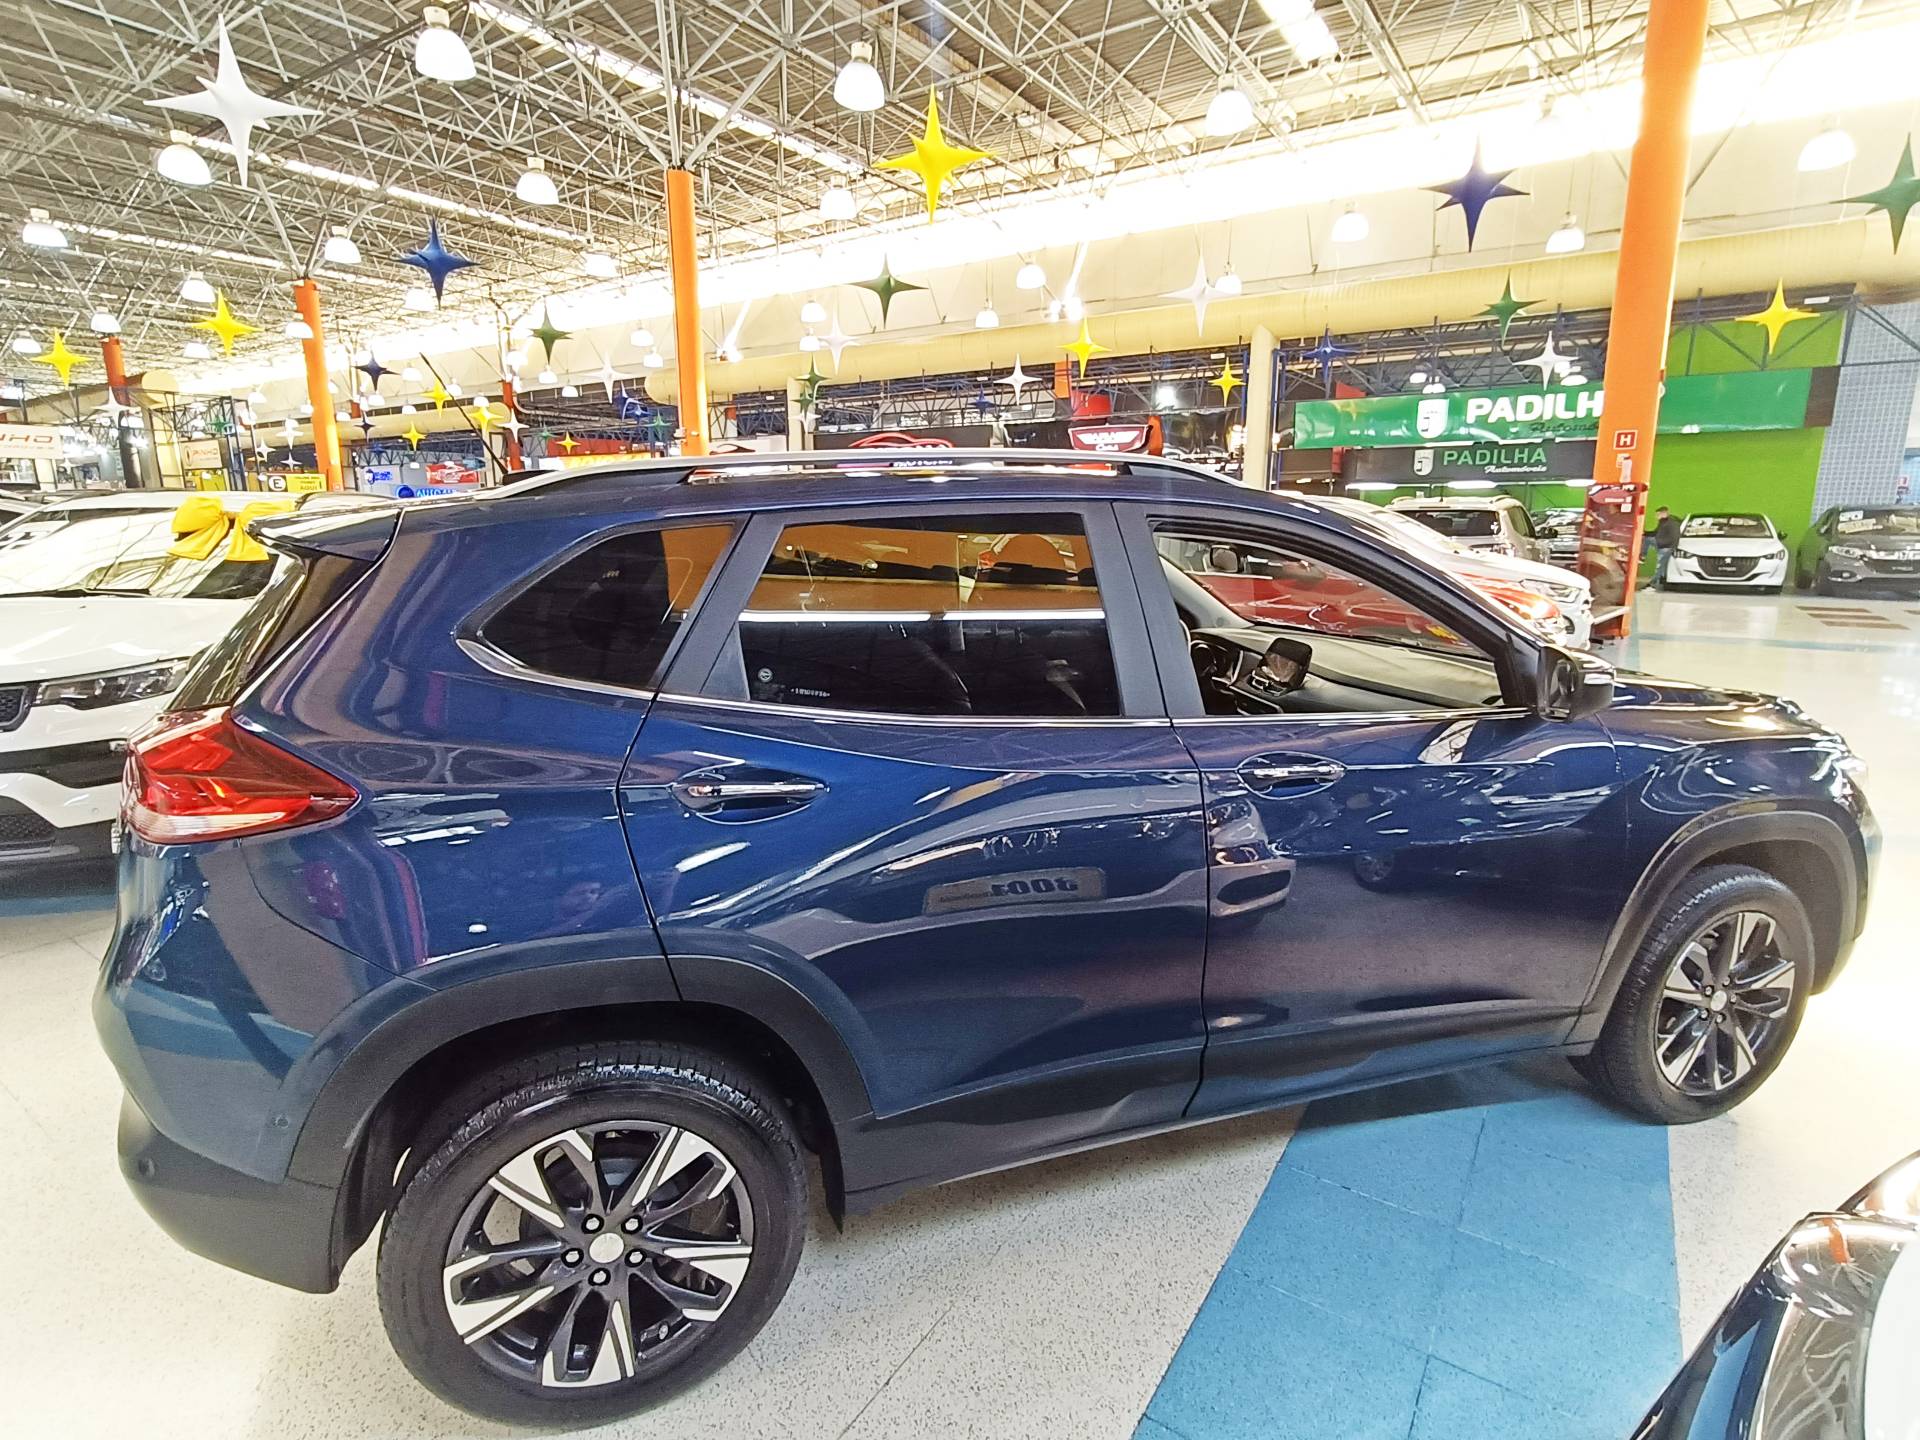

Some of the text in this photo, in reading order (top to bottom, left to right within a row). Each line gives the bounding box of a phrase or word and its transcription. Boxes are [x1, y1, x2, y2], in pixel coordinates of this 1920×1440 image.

[1619, 434, 1632, 447] H
[1443, 447, 1547, 466] PADILHA
[273, 478, 283, 490] E
